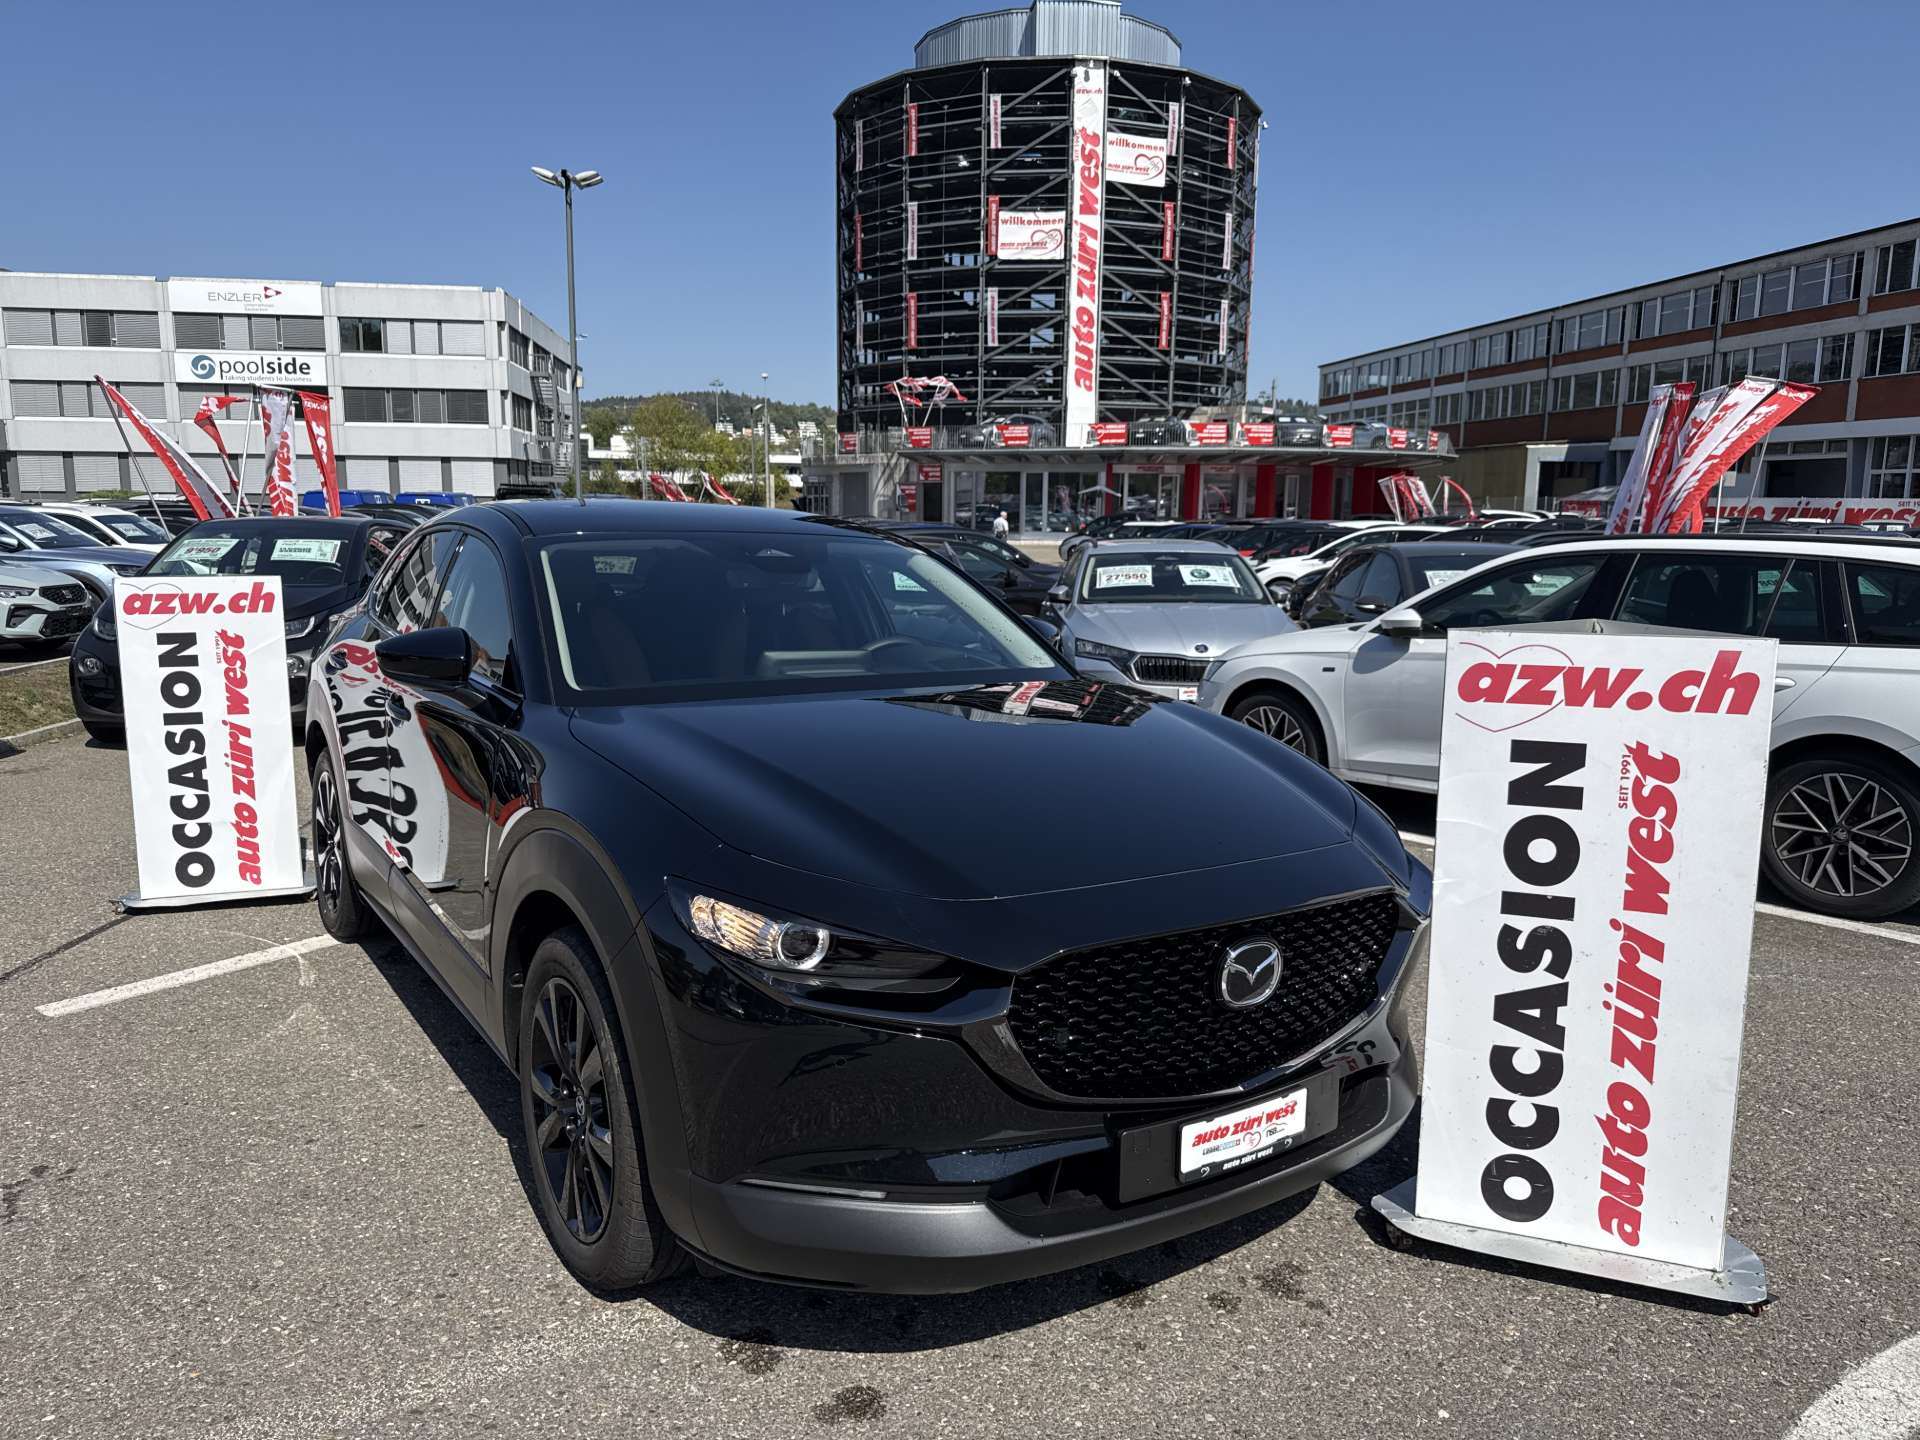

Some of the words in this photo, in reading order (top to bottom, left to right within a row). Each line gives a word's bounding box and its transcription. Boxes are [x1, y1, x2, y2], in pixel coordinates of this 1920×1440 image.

[1079, 126, 1101, 215] west
[1108, 137, 1165, 152] willkommen
[1000, 215, 1064, 226] willkommen
[1072, 219, 1098, 304] züri
[208, 291, 262, 302] ENZLER
[219, 355, 311, 380] poolside
[1072, 305, 1095, 392] auto
[123, 581, 275, 615] azw.ch
[215, 628, 250, 715] west
[1457, 650, 1760, 715] azw.ch
[156, 632, 215, 888] OCCASION
[221, 719, 256, 801] züri
[1618, 781, 1628, 810] SEIT
[1619, 753, 1631, 780] 1991
[230, 802, 262, 886] auto
[1621, 740, 1681, 916] west
[1481, 738, 1587, 1223] OCCASION
[1601, 918, 1668, 1085] züri
[1192, 1124, 1230, 1147] auto
[1231, 1111, 1264, 1136] züri
[1265, 1101, 1298, 1123] west
[1222, 1159, 1241, 1171] auto
[1241, 1153, 1256, 1165] züri
[1257, 1147, 1274, 1159] west
[1594, 1096, 1652, 1247] auto
